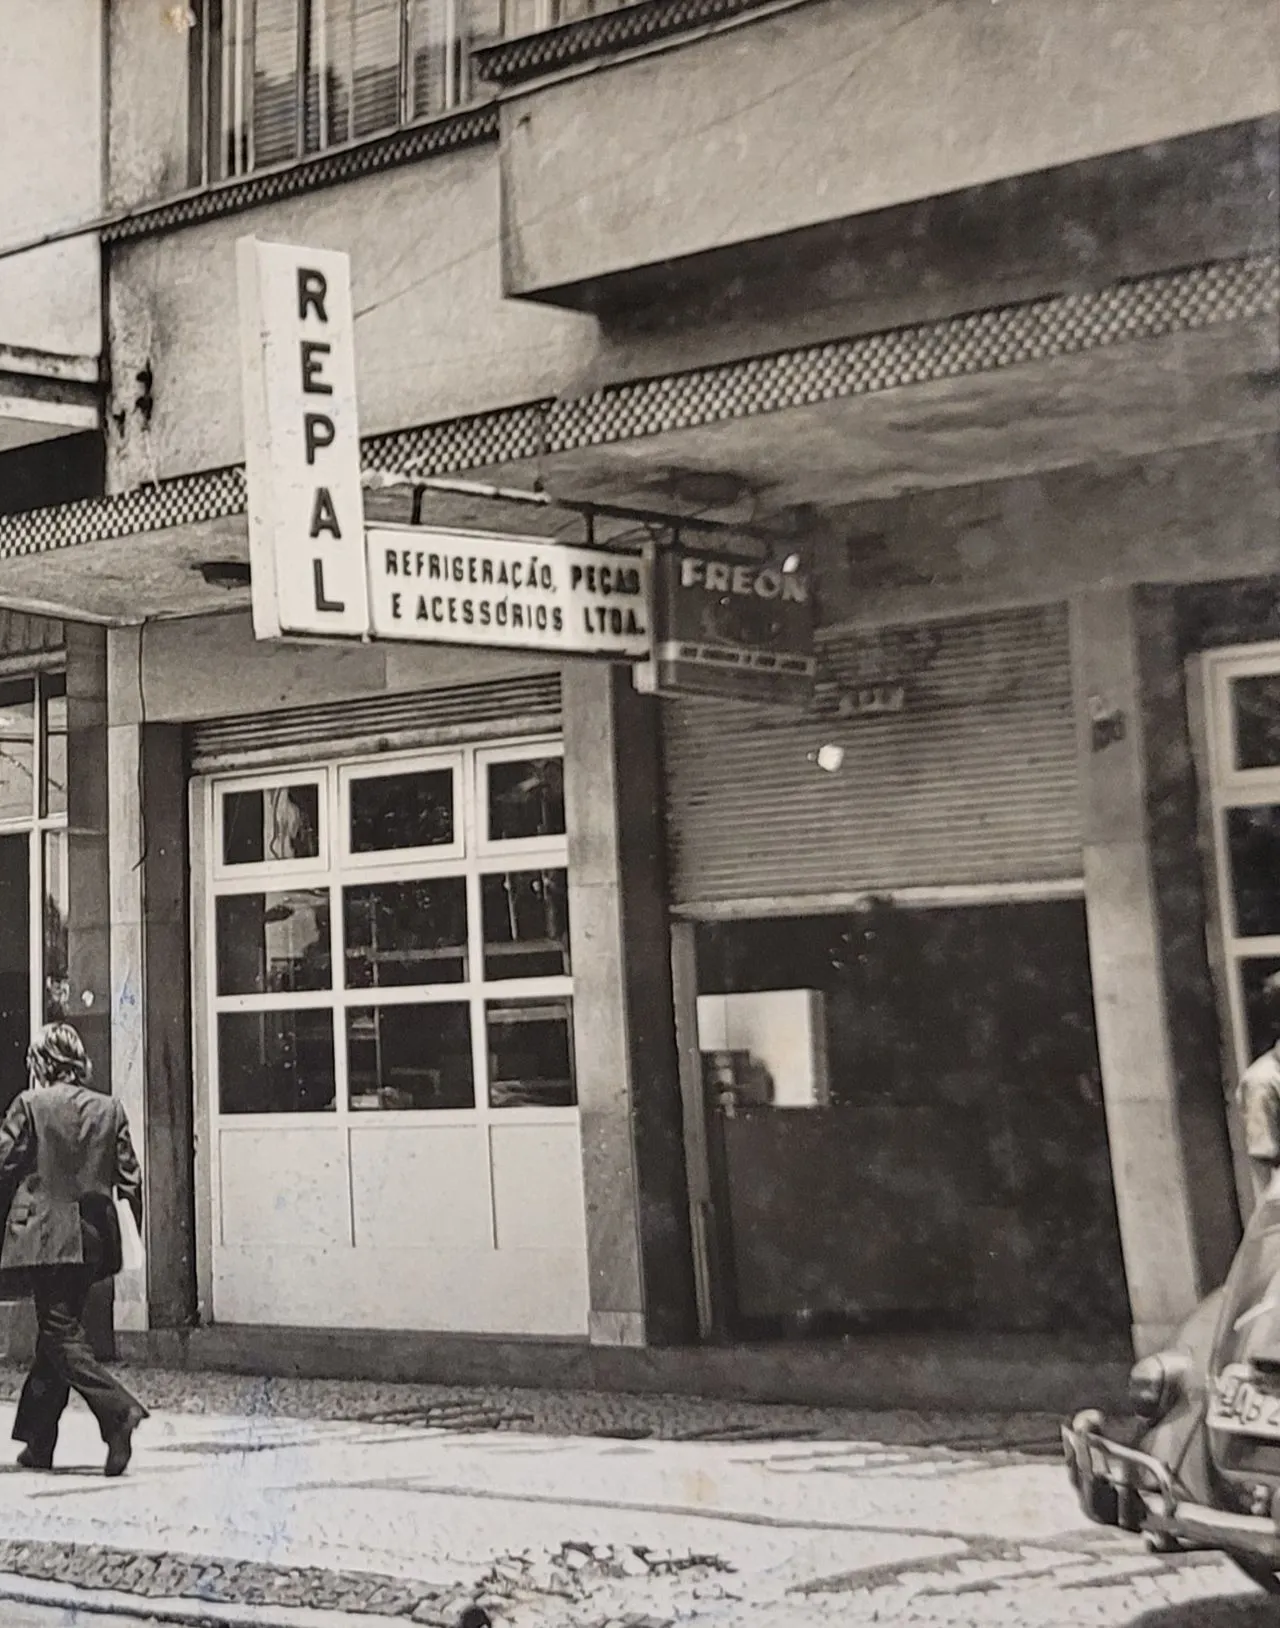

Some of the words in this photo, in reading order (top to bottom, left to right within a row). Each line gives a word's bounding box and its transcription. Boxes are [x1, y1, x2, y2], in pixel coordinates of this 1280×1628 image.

[297, 267, 345, 613] REPAL
[385, 549, 557, 593] REFRIGERAÇÃO,
[681, 557, 810, 602] FREON
[392, 592, 402, 619] E
[416, 595, 563, 631] ACESSÓRIOS
[584, 606, 646, 635] LTDA.
